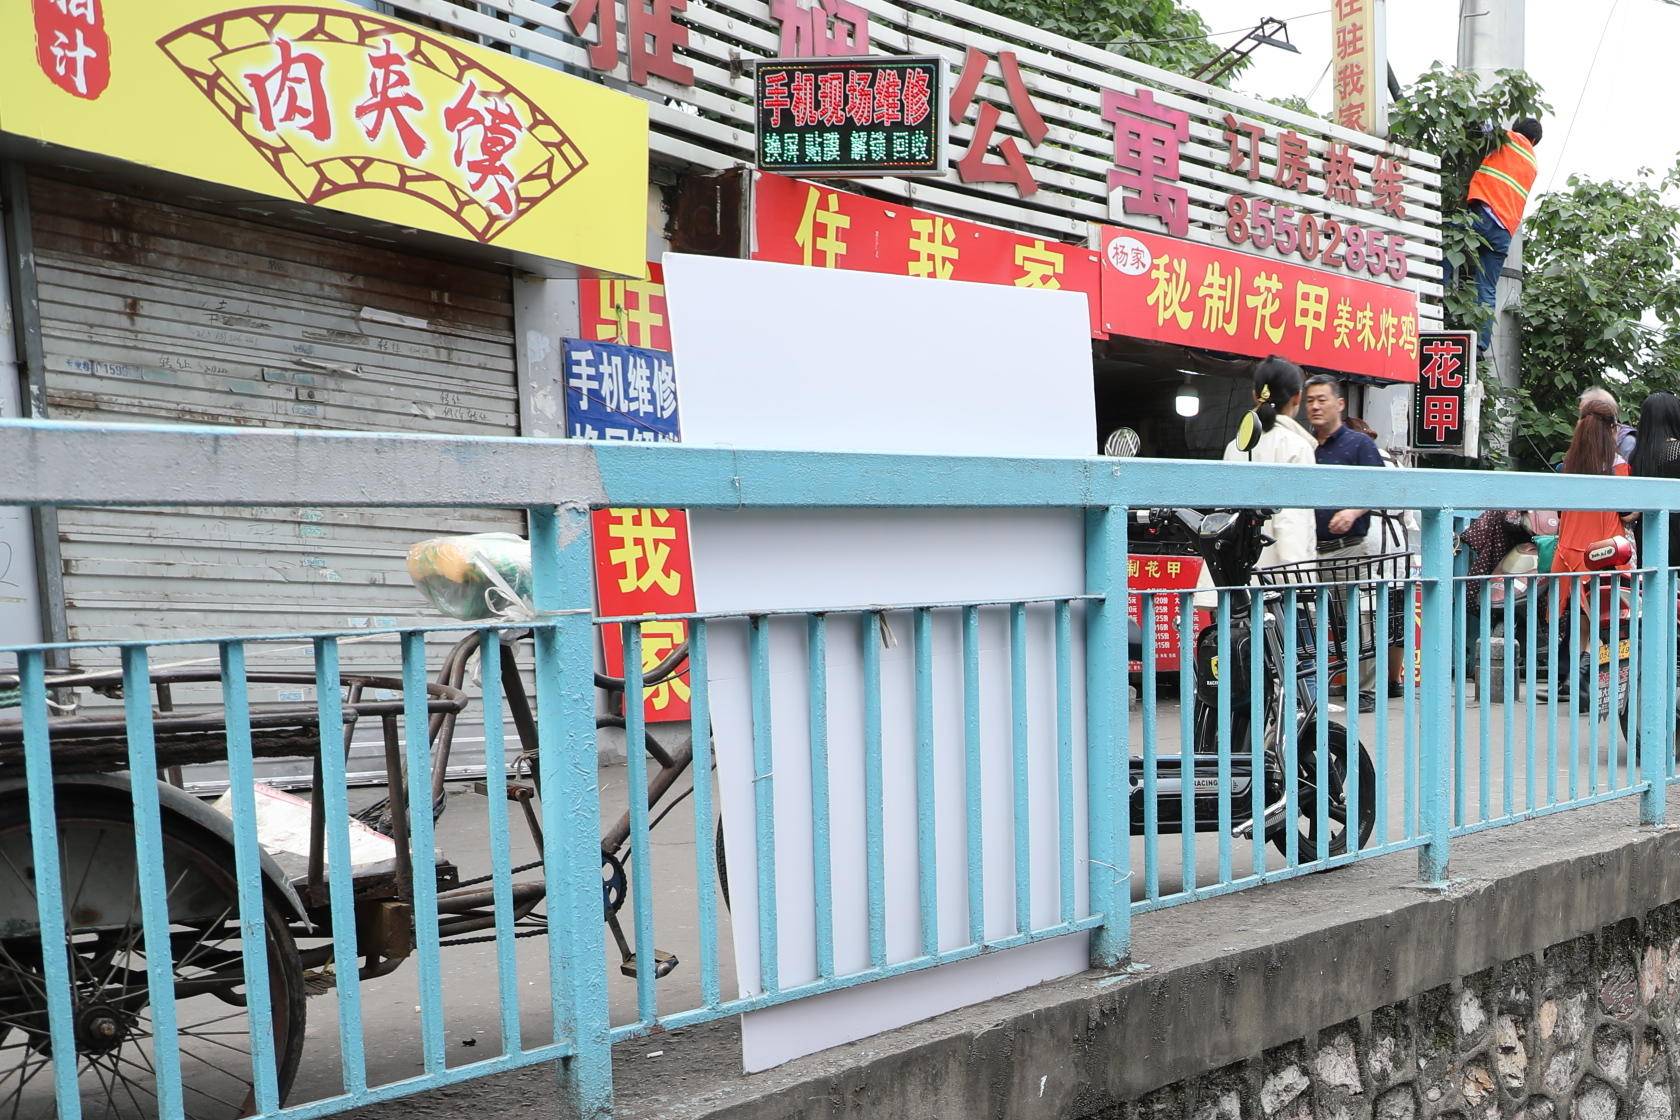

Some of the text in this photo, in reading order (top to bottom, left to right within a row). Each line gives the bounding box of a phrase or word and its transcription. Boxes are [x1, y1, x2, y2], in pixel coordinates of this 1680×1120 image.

[244, 37, 523, 216] 肉夹馍
[763, 67, 931, 127] 手机现场维修
[1225, 113, 1407, 218] 订房热线
[1111, 242, 1148, 271] 杨家
[1226, 194, 1408, 281] 85502855
[1147, 253, 1419, 361] 秘制花甲 美味炸鸡
[569, 349, 678, 420] 手机维修
[1421, 340, 1463, 442] 花甲
